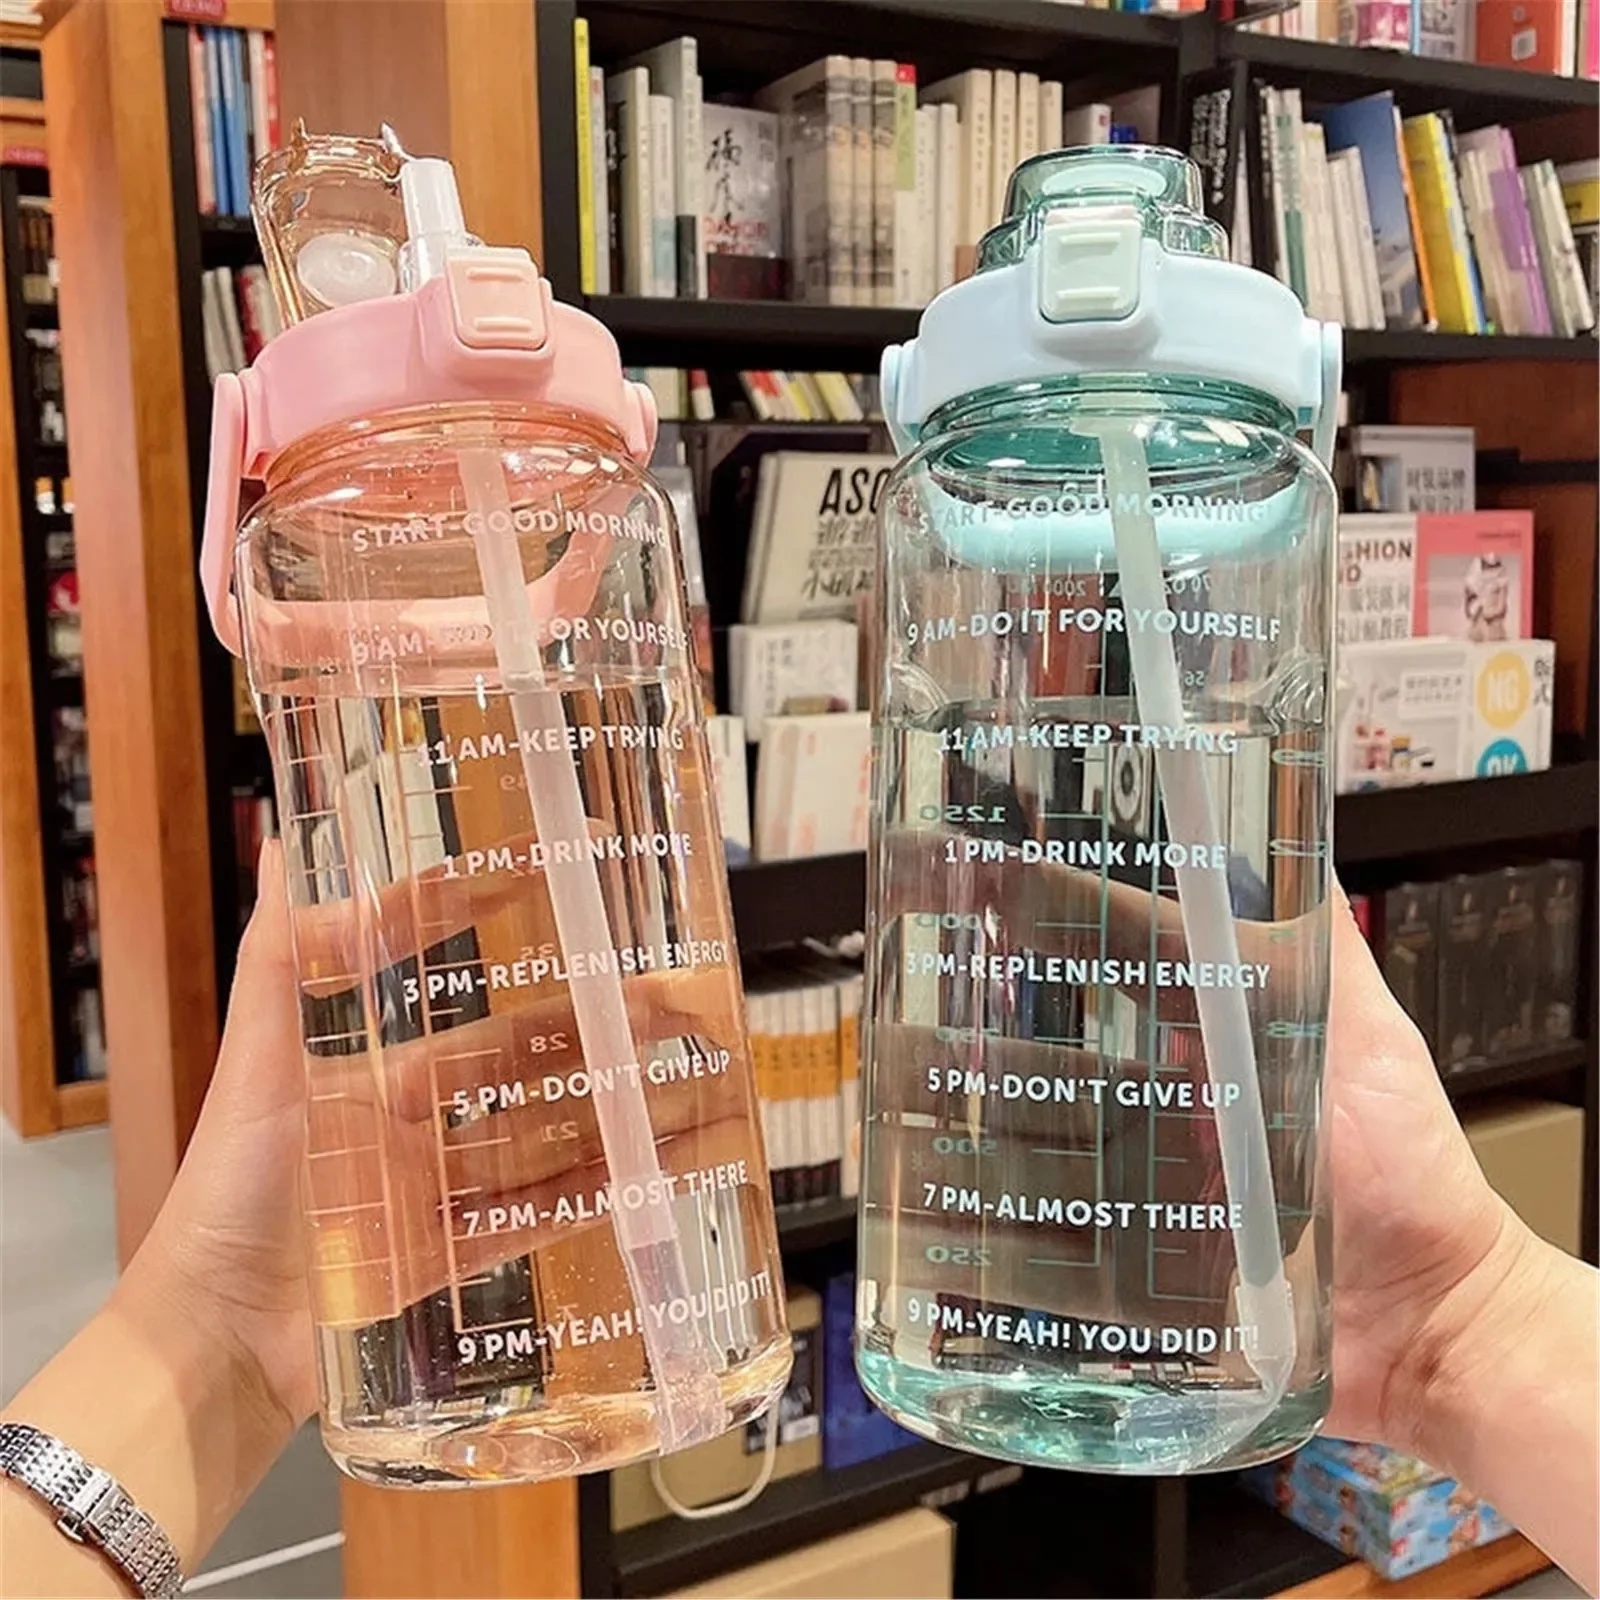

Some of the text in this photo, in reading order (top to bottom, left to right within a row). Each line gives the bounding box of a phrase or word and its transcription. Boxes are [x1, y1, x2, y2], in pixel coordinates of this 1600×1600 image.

[1116, 493, 1267, 525] MORNING
[352, 510, 668, 552] START-GOOD MORNING
[595, 617, 688, 650] YOURSELF
[907, 607, 1281, 646] 9 AM-DO IT FOR YOURSELF
[459, 726, 596, 762] AM-KEEP
[602, 725, 684, 750] TRYING
[939, 724, 1240, 754] 11 AM-KEEP TRYING
[443, 854, 456, 879] 1
[466, 834, 625, 875] PM-DRINK
[944, 840, 1227, 869] 1 PM-DRINK MORE
[403, 940, 729, 1005] 3 PM-REPLENISH ENERGY
[906, 952, 1270, 989] 3 PM-REPLENISH ENERGY
[452, 1091, 471, 1117] 5
[479, 1062, 640, 1113] PM-DON'T
[646, 1052, 704, 1085] GIVE
[708, 1049, 731, 1073] UP
[927, 1067, 1241, 1108] 5 PM-DON'T GIVE UP
[463, 1160, 748, 1236] 7 PM-ALMOST THERE
[923, 1181, 1242, 1231] 7 PM-ALMOST THERE
[458, 1270, 772, 1364] 9 PM-YEAH! YOU DID IT!
[908, 1297, 1259, 1354] 9 PM-YEAH! YOU DID IT!
